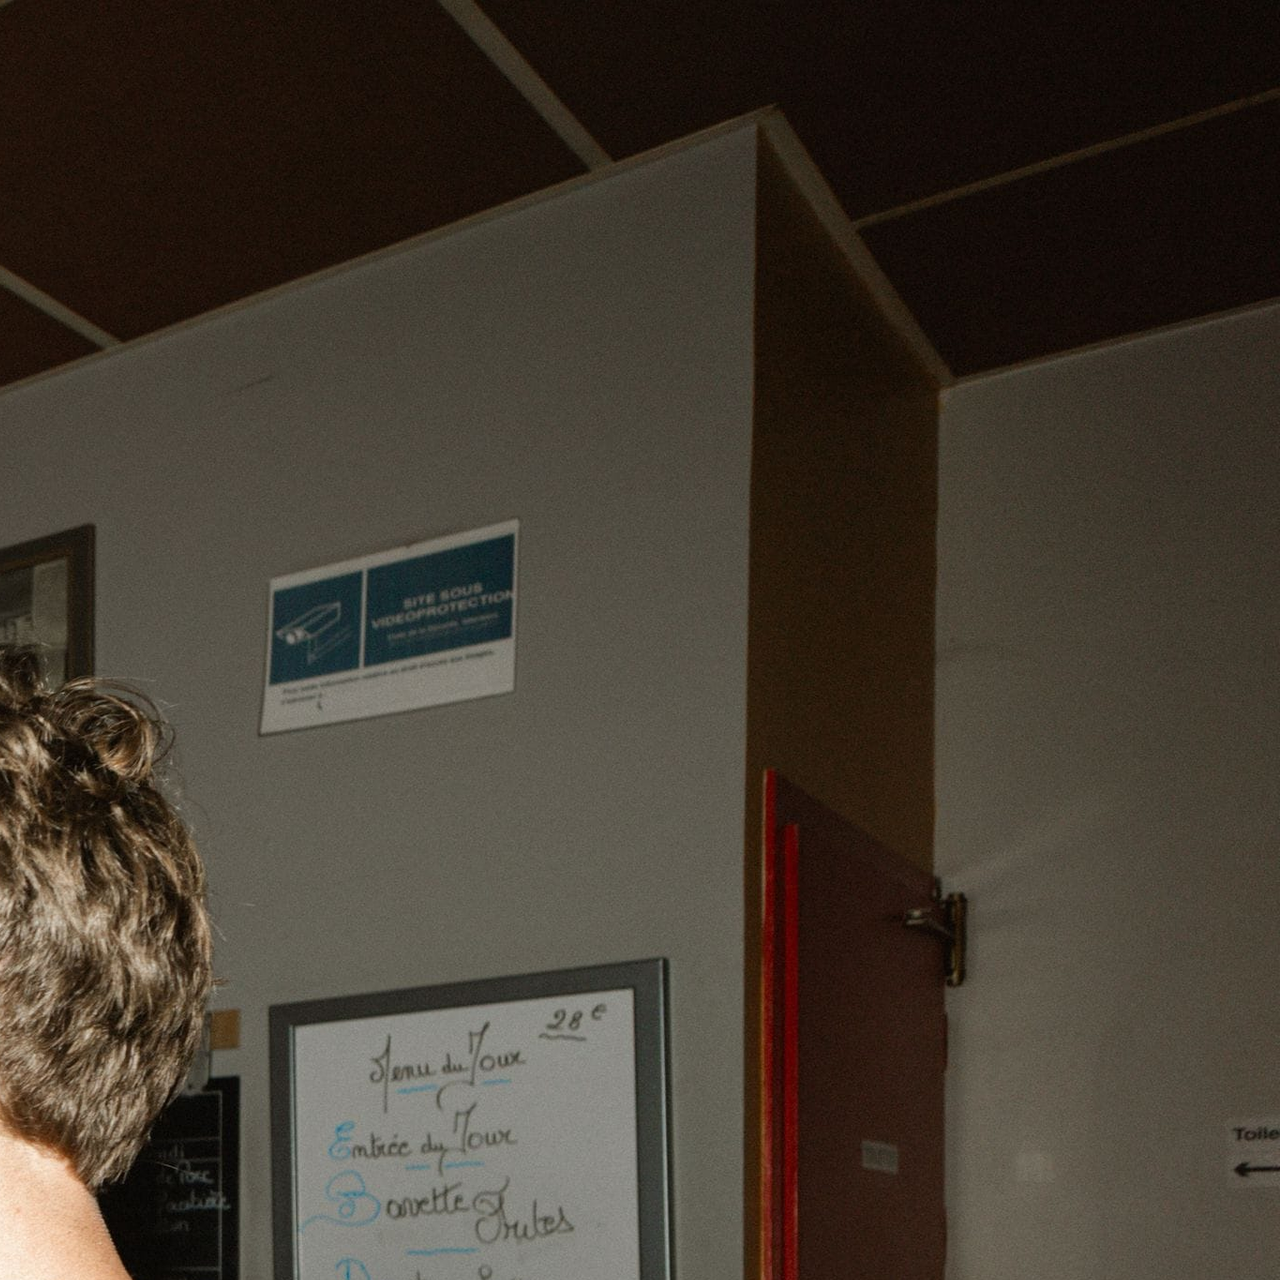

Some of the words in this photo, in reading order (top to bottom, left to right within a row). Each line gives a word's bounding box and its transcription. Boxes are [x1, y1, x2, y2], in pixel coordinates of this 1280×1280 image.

[403, 592, 436, 610] SITE
[441, 582, 483, 601] SOUS
[442, 1053, 469, 1073] du
[421, 1132, 446, 1153] du
